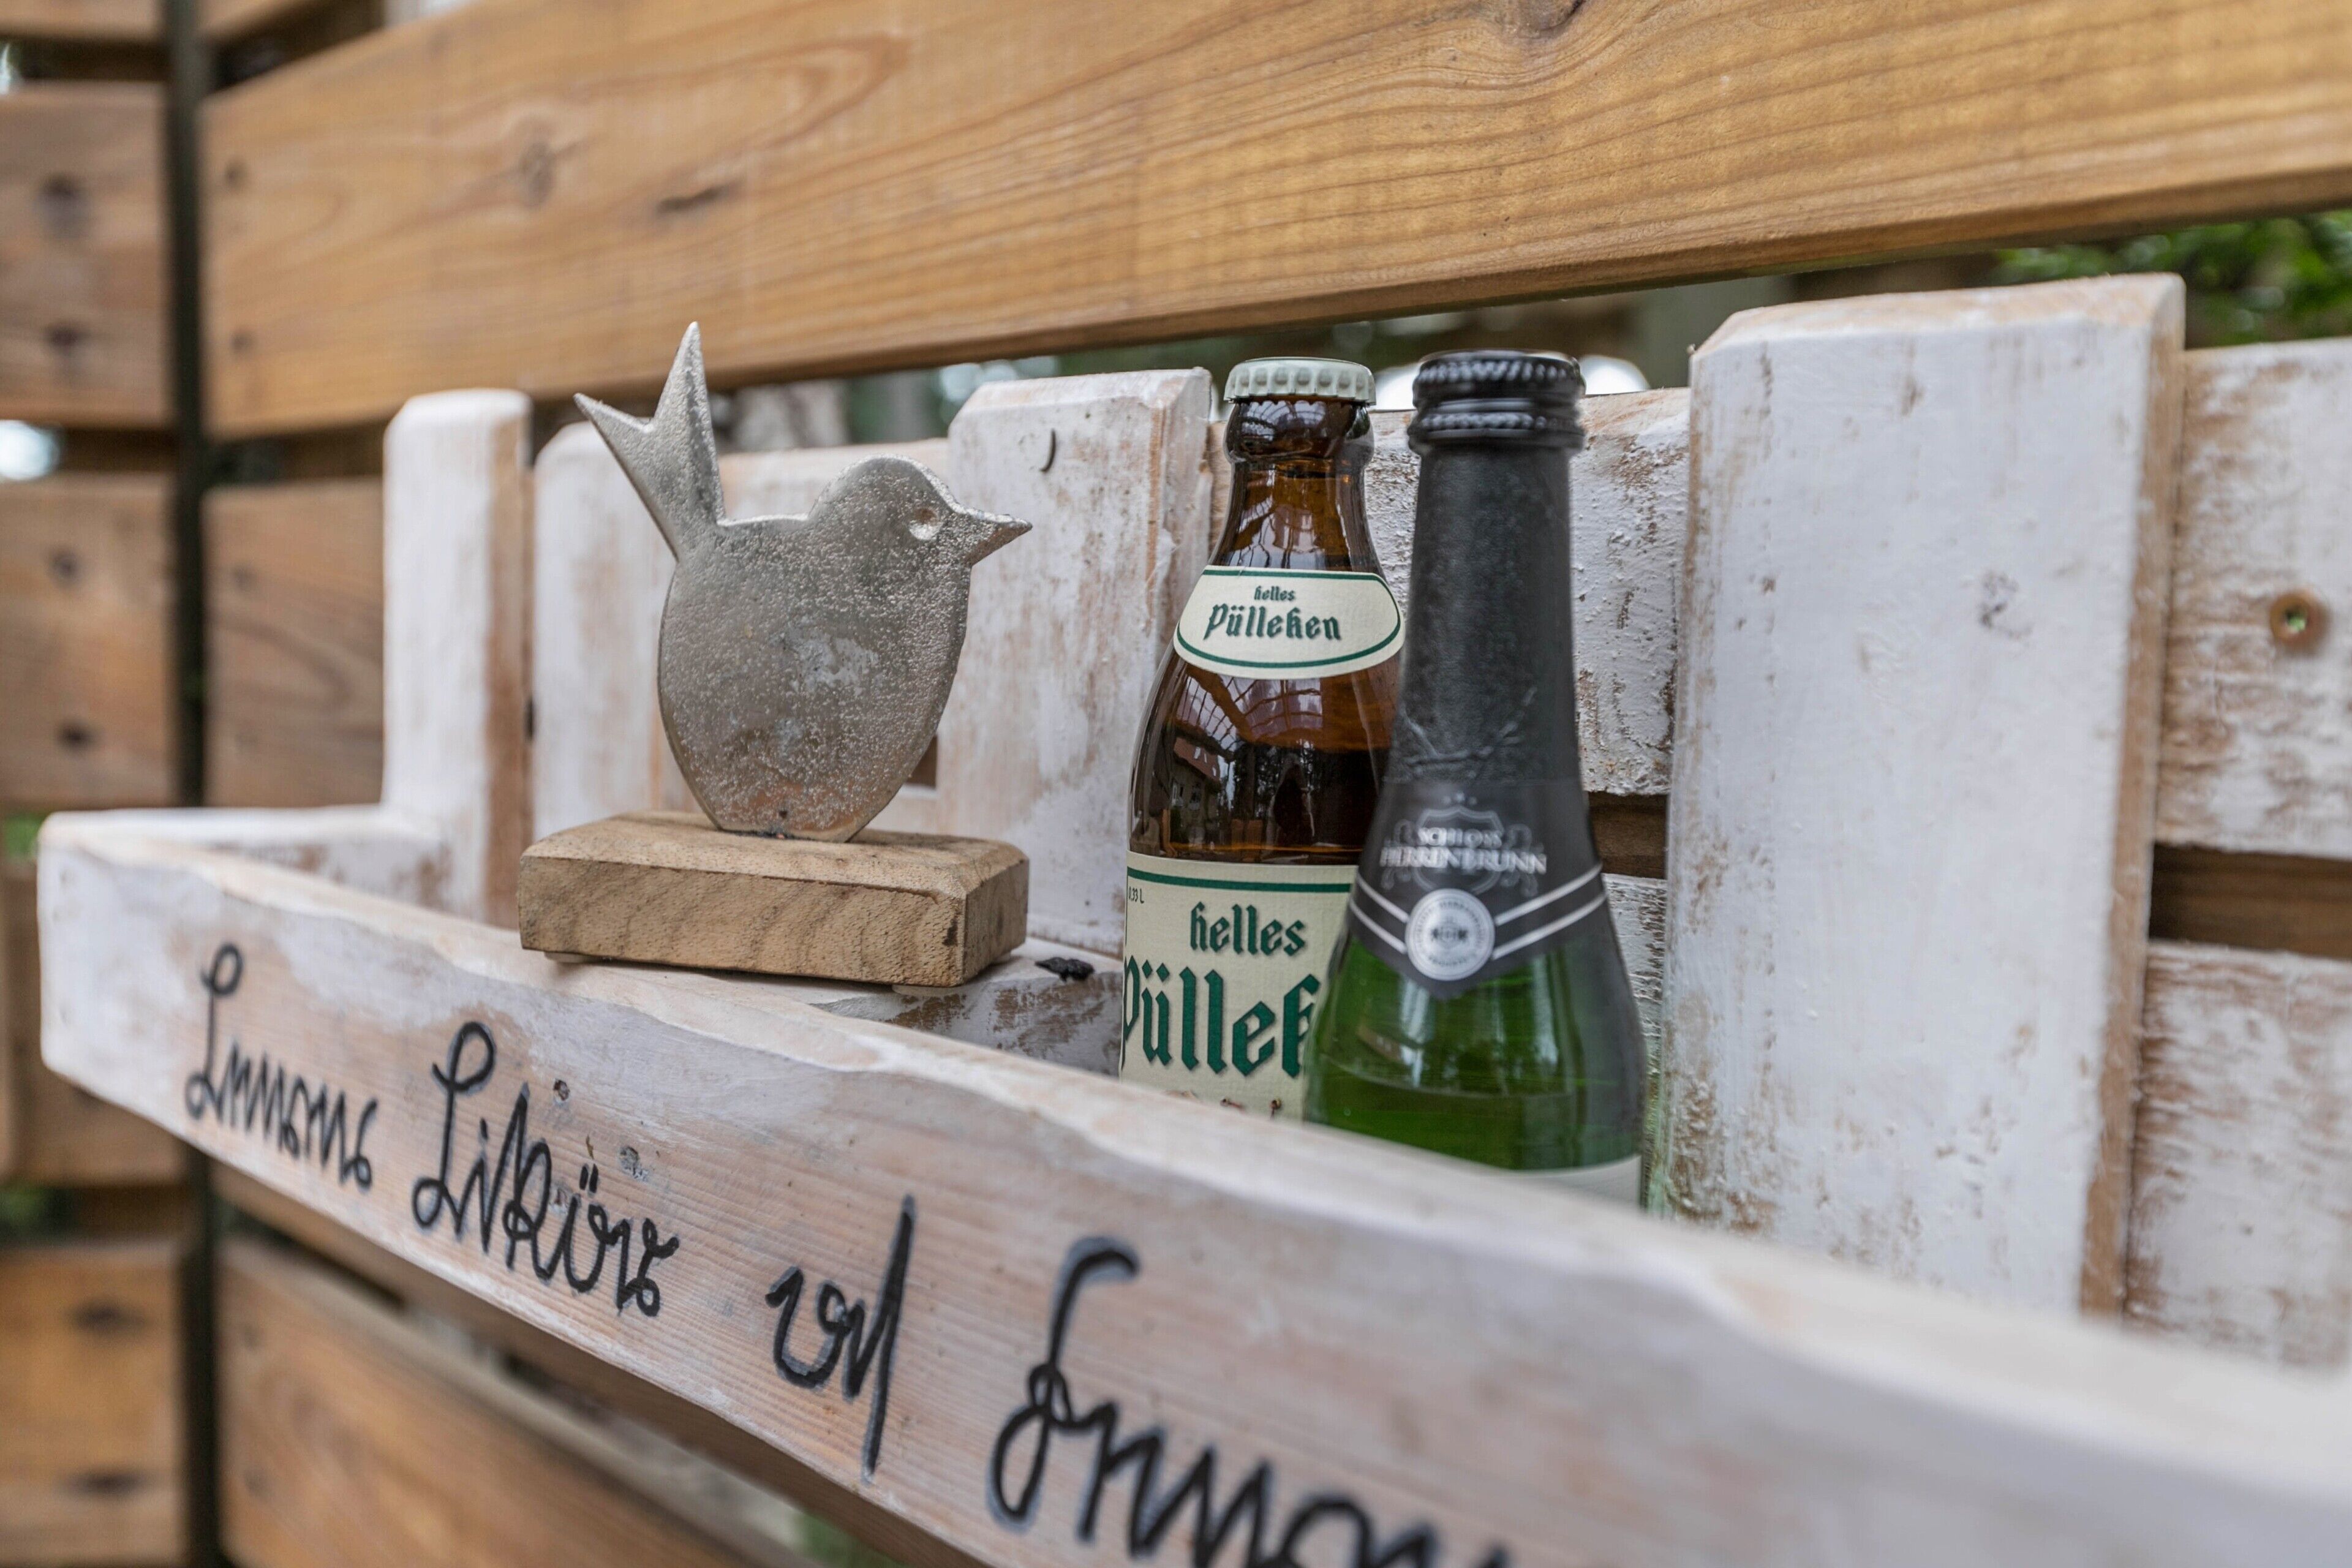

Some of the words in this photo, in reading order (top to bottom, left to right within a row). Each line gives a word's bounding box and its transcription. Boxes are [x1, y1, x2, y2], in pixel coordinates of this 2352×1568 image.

[1253, 586, 1296, 601] helles
[1203, 603, 1342, 640] Pülleken
[1190, 902, 1306, 956] helles
